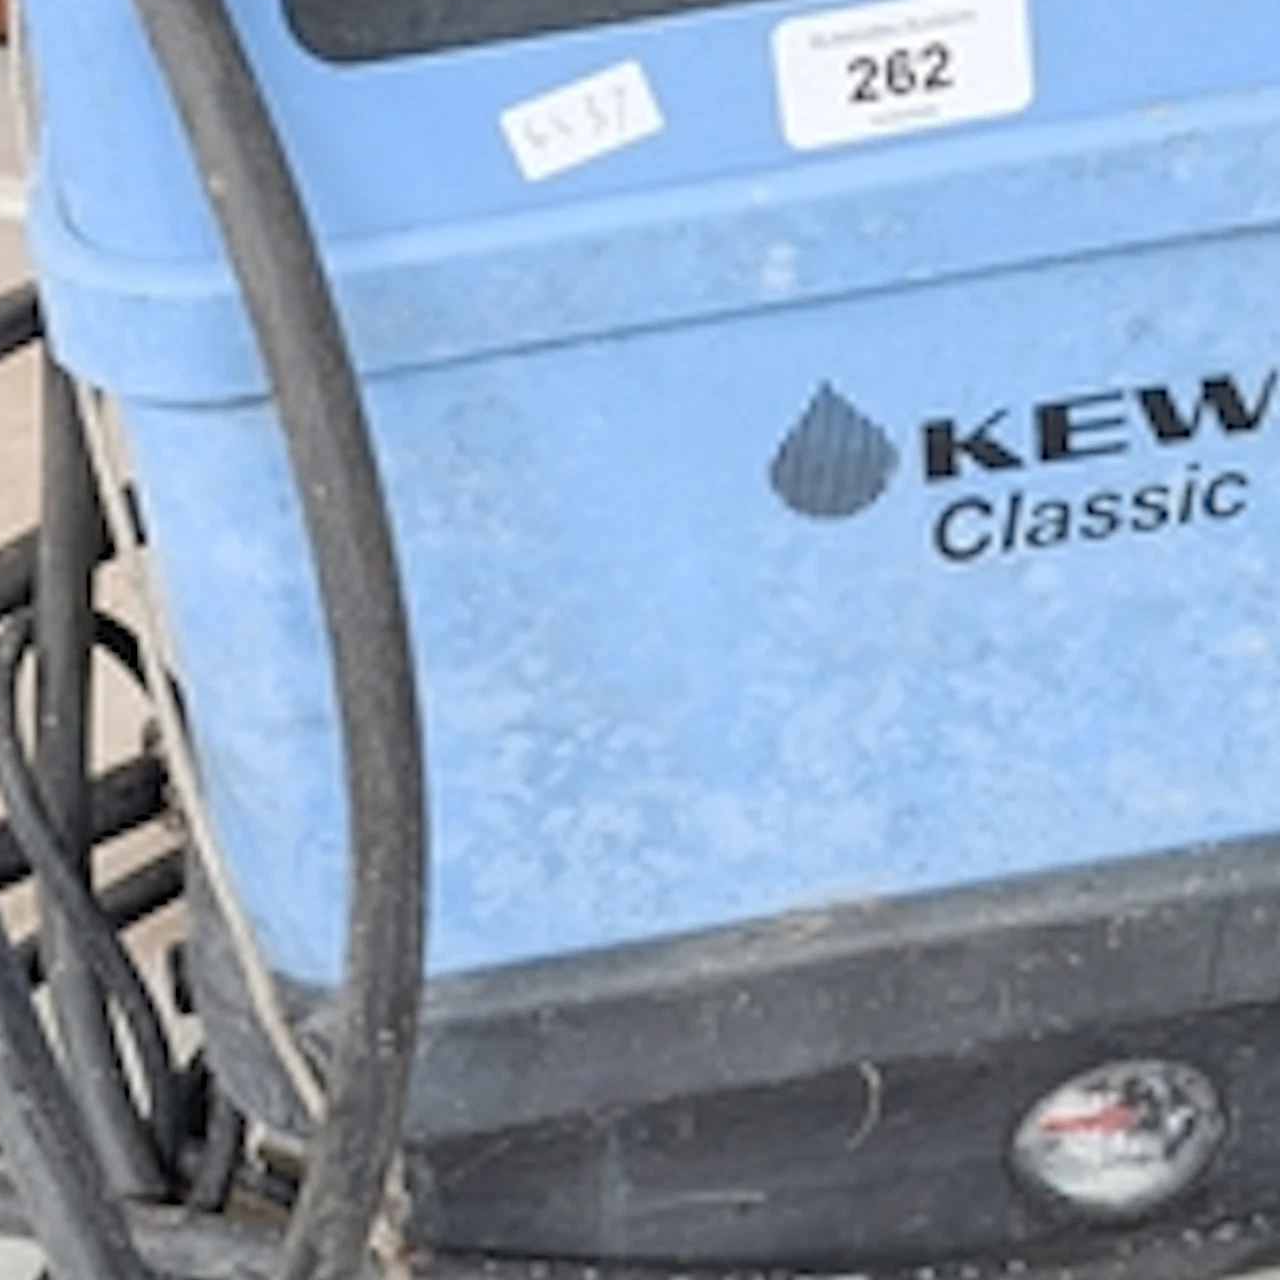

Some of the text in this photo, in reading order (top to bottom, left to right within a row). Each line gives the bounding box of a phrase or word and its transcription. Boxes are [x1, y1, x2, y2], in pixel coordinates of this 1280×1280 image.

[845, 41, 955, 106] 262
[919, 370, 1279, 484] KEW
[932, 463, 1251, 562] Classic
